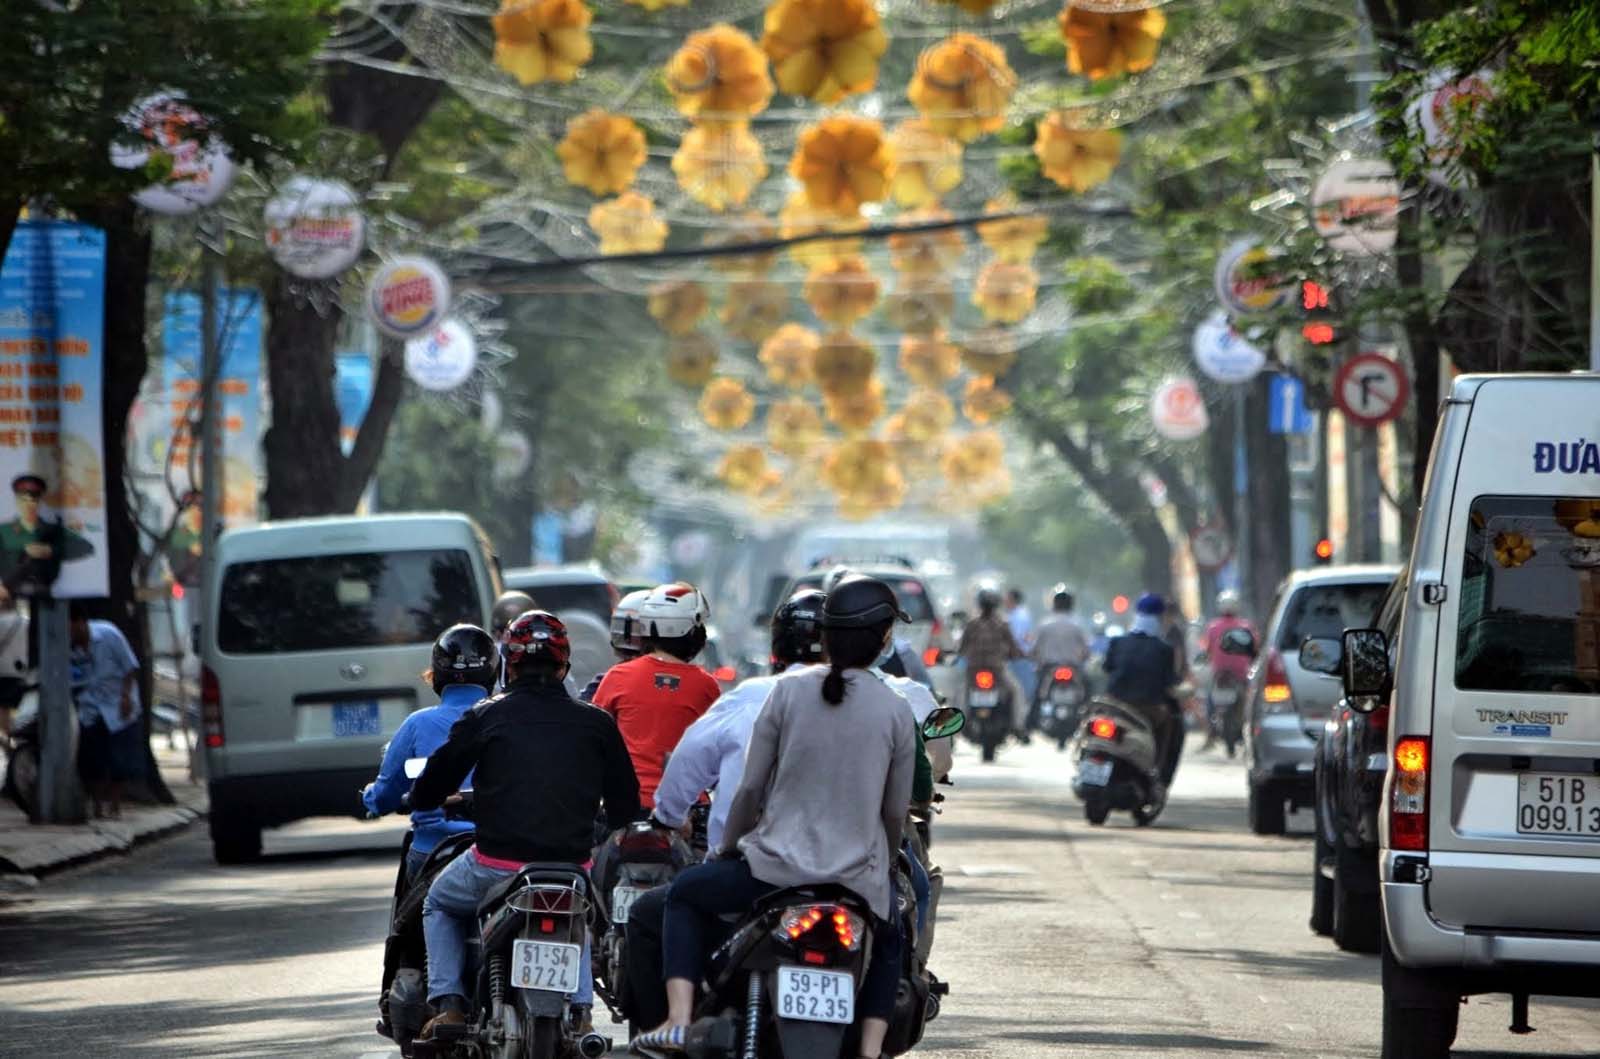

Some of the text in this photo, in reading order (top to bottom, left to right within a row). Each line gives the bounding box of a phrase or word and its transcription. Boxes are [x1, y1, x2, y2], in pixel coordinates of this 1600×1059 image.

[1533, 438, 1600, 474] ĐƯA
[1476, 708, 1568, 725] TRANSIT
[1539, 777, 1585, 804] 51B
[1520, 804, 1600, 833] 099.13
[522, 965, 568, 987] 8724
[790, 972, 839, 996] 59-P1
[783, 993, 848, 1019] 862.35
